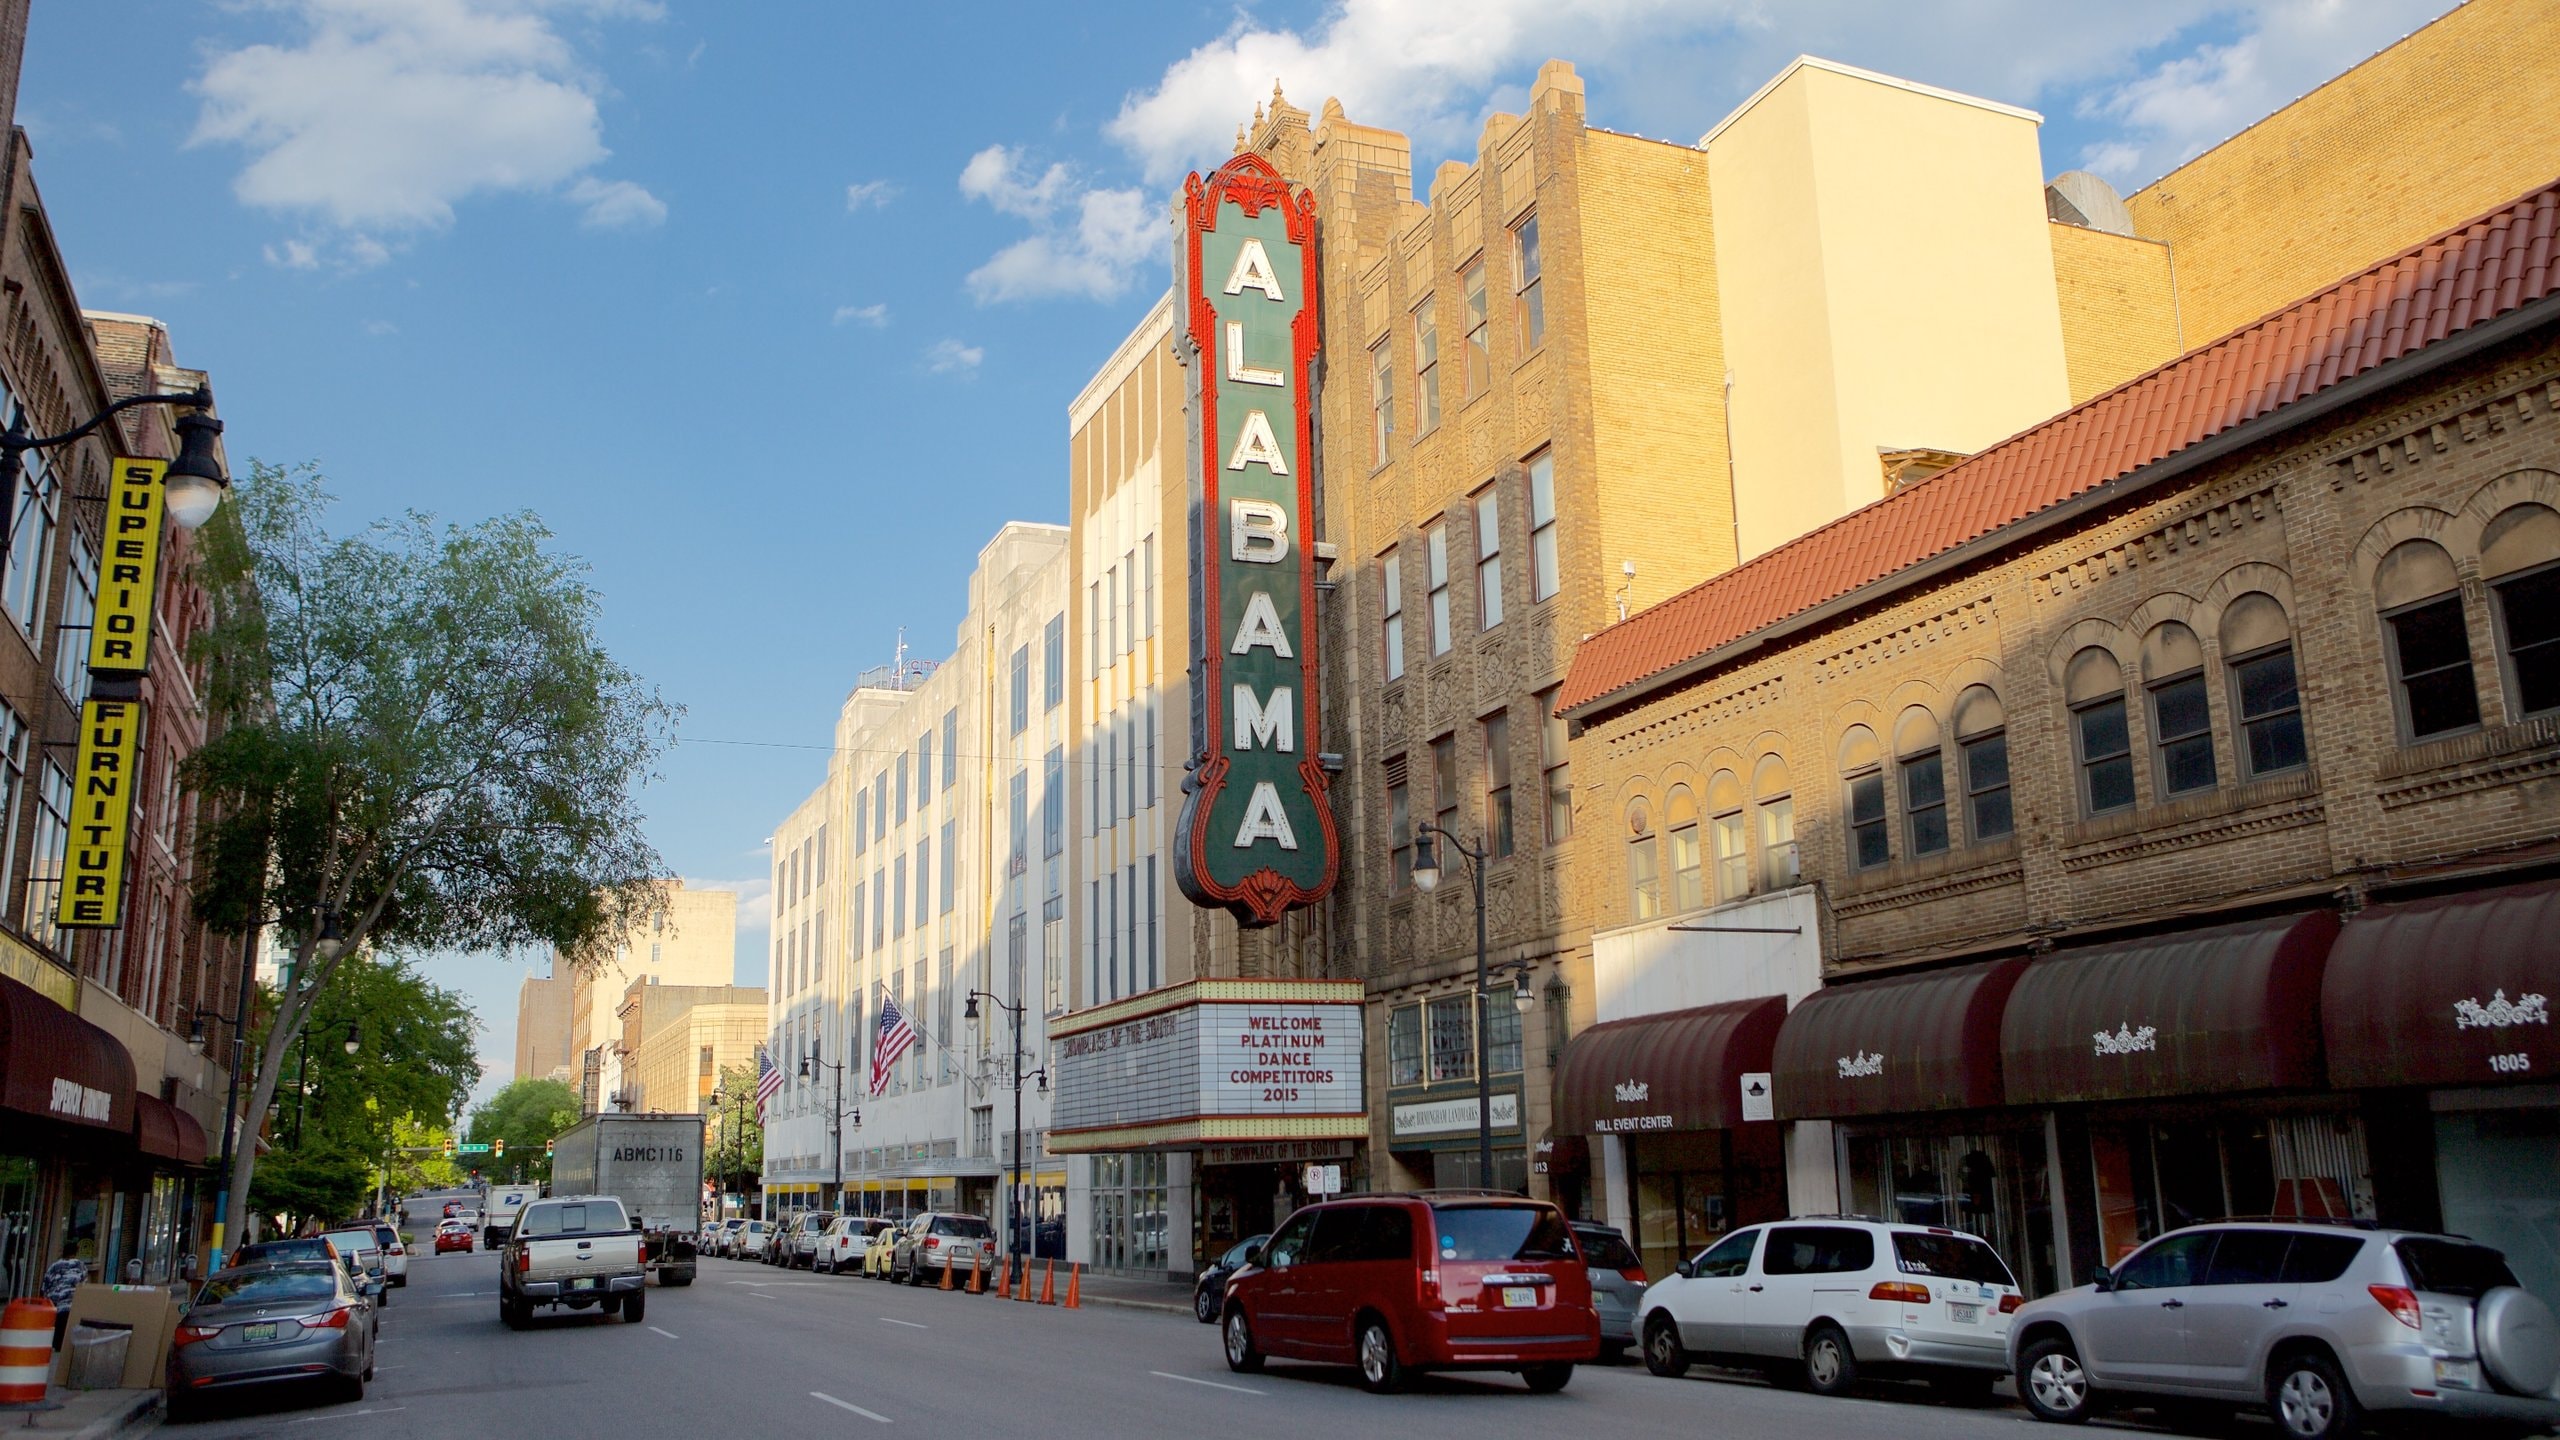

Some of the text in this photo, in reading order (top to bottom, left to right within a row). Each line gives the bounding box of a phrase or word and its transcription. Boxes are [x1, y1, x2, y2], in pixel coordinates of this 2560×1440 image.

[1223, 238, 1298, 851] ALABAMA
[106, 466, 154, 661] SUPERIOR
[73, 703, 125, 921] FURNITURE
[1111, 1027, 1122, 1048] OF
[1126, 1023, 1143, 1046] THE
[1146, 1014, 1177, 1041] SOUTH
[1249, 1017, 1322, 1030] WELCOME
[1241, 1035, 1325, 1048] PLATINUM
[1259, 1052, 1312, 1066] DANCE
[2488, 1053, 2530, 1073] 1805
[1230, 1070, 1333, 1084] COMPETITORS
[1263, 1088, 1298, 1102] 2015
[1595, 1115, 1673, 1132] HILL EVENT CENTER
[1211, 1140, 1340, 1163] THE SHOWPLACE OF THE SOUTH
